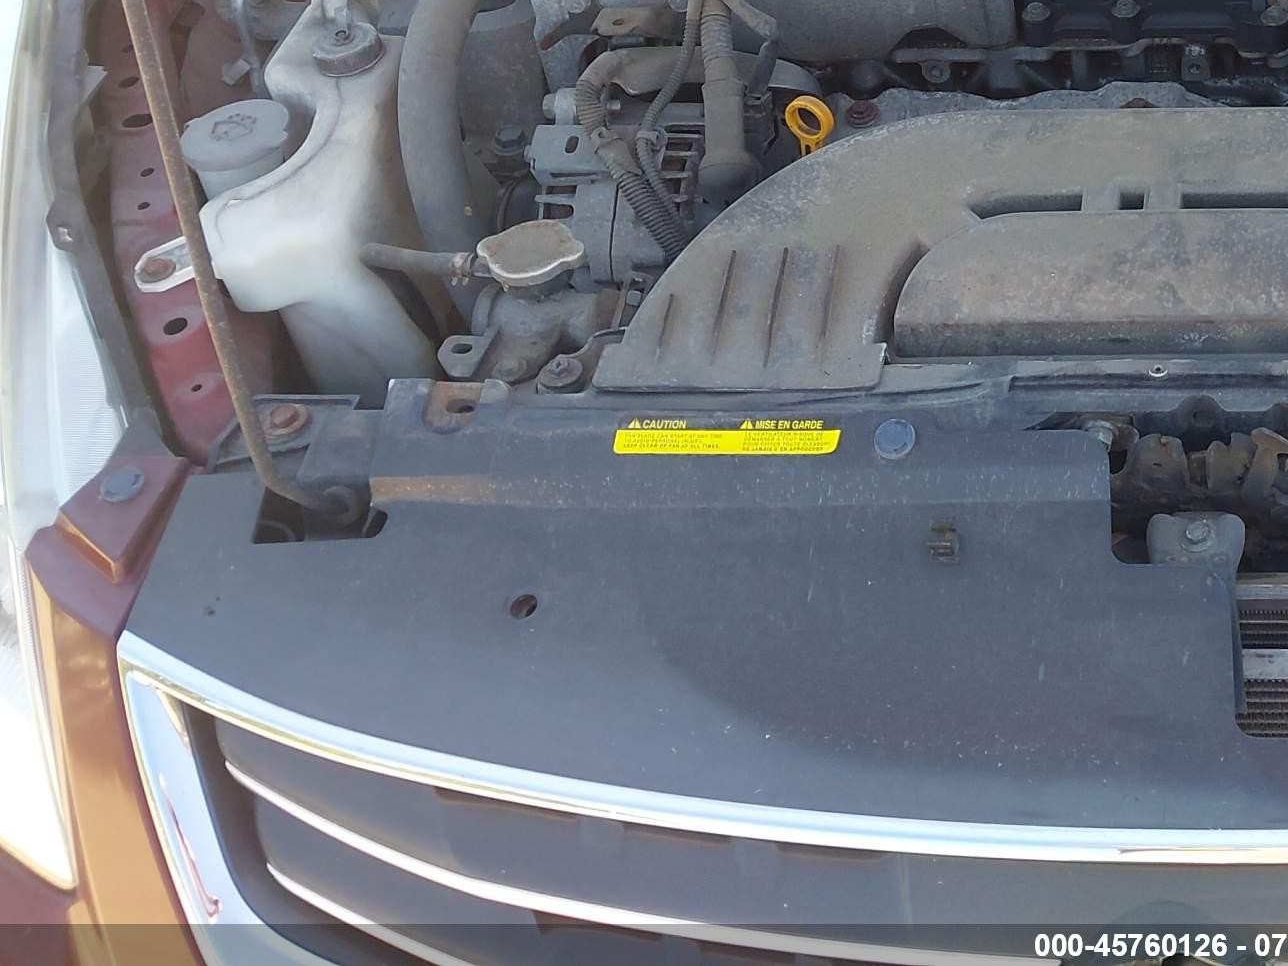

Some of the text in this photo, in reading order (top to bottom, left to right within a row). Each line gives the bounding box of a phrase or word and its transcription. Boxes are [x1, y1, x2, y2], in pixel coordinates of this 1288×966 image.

[642, 420, 687, 429] CAUTION
[754, 420, 824, 429] MISE EN GARDE
